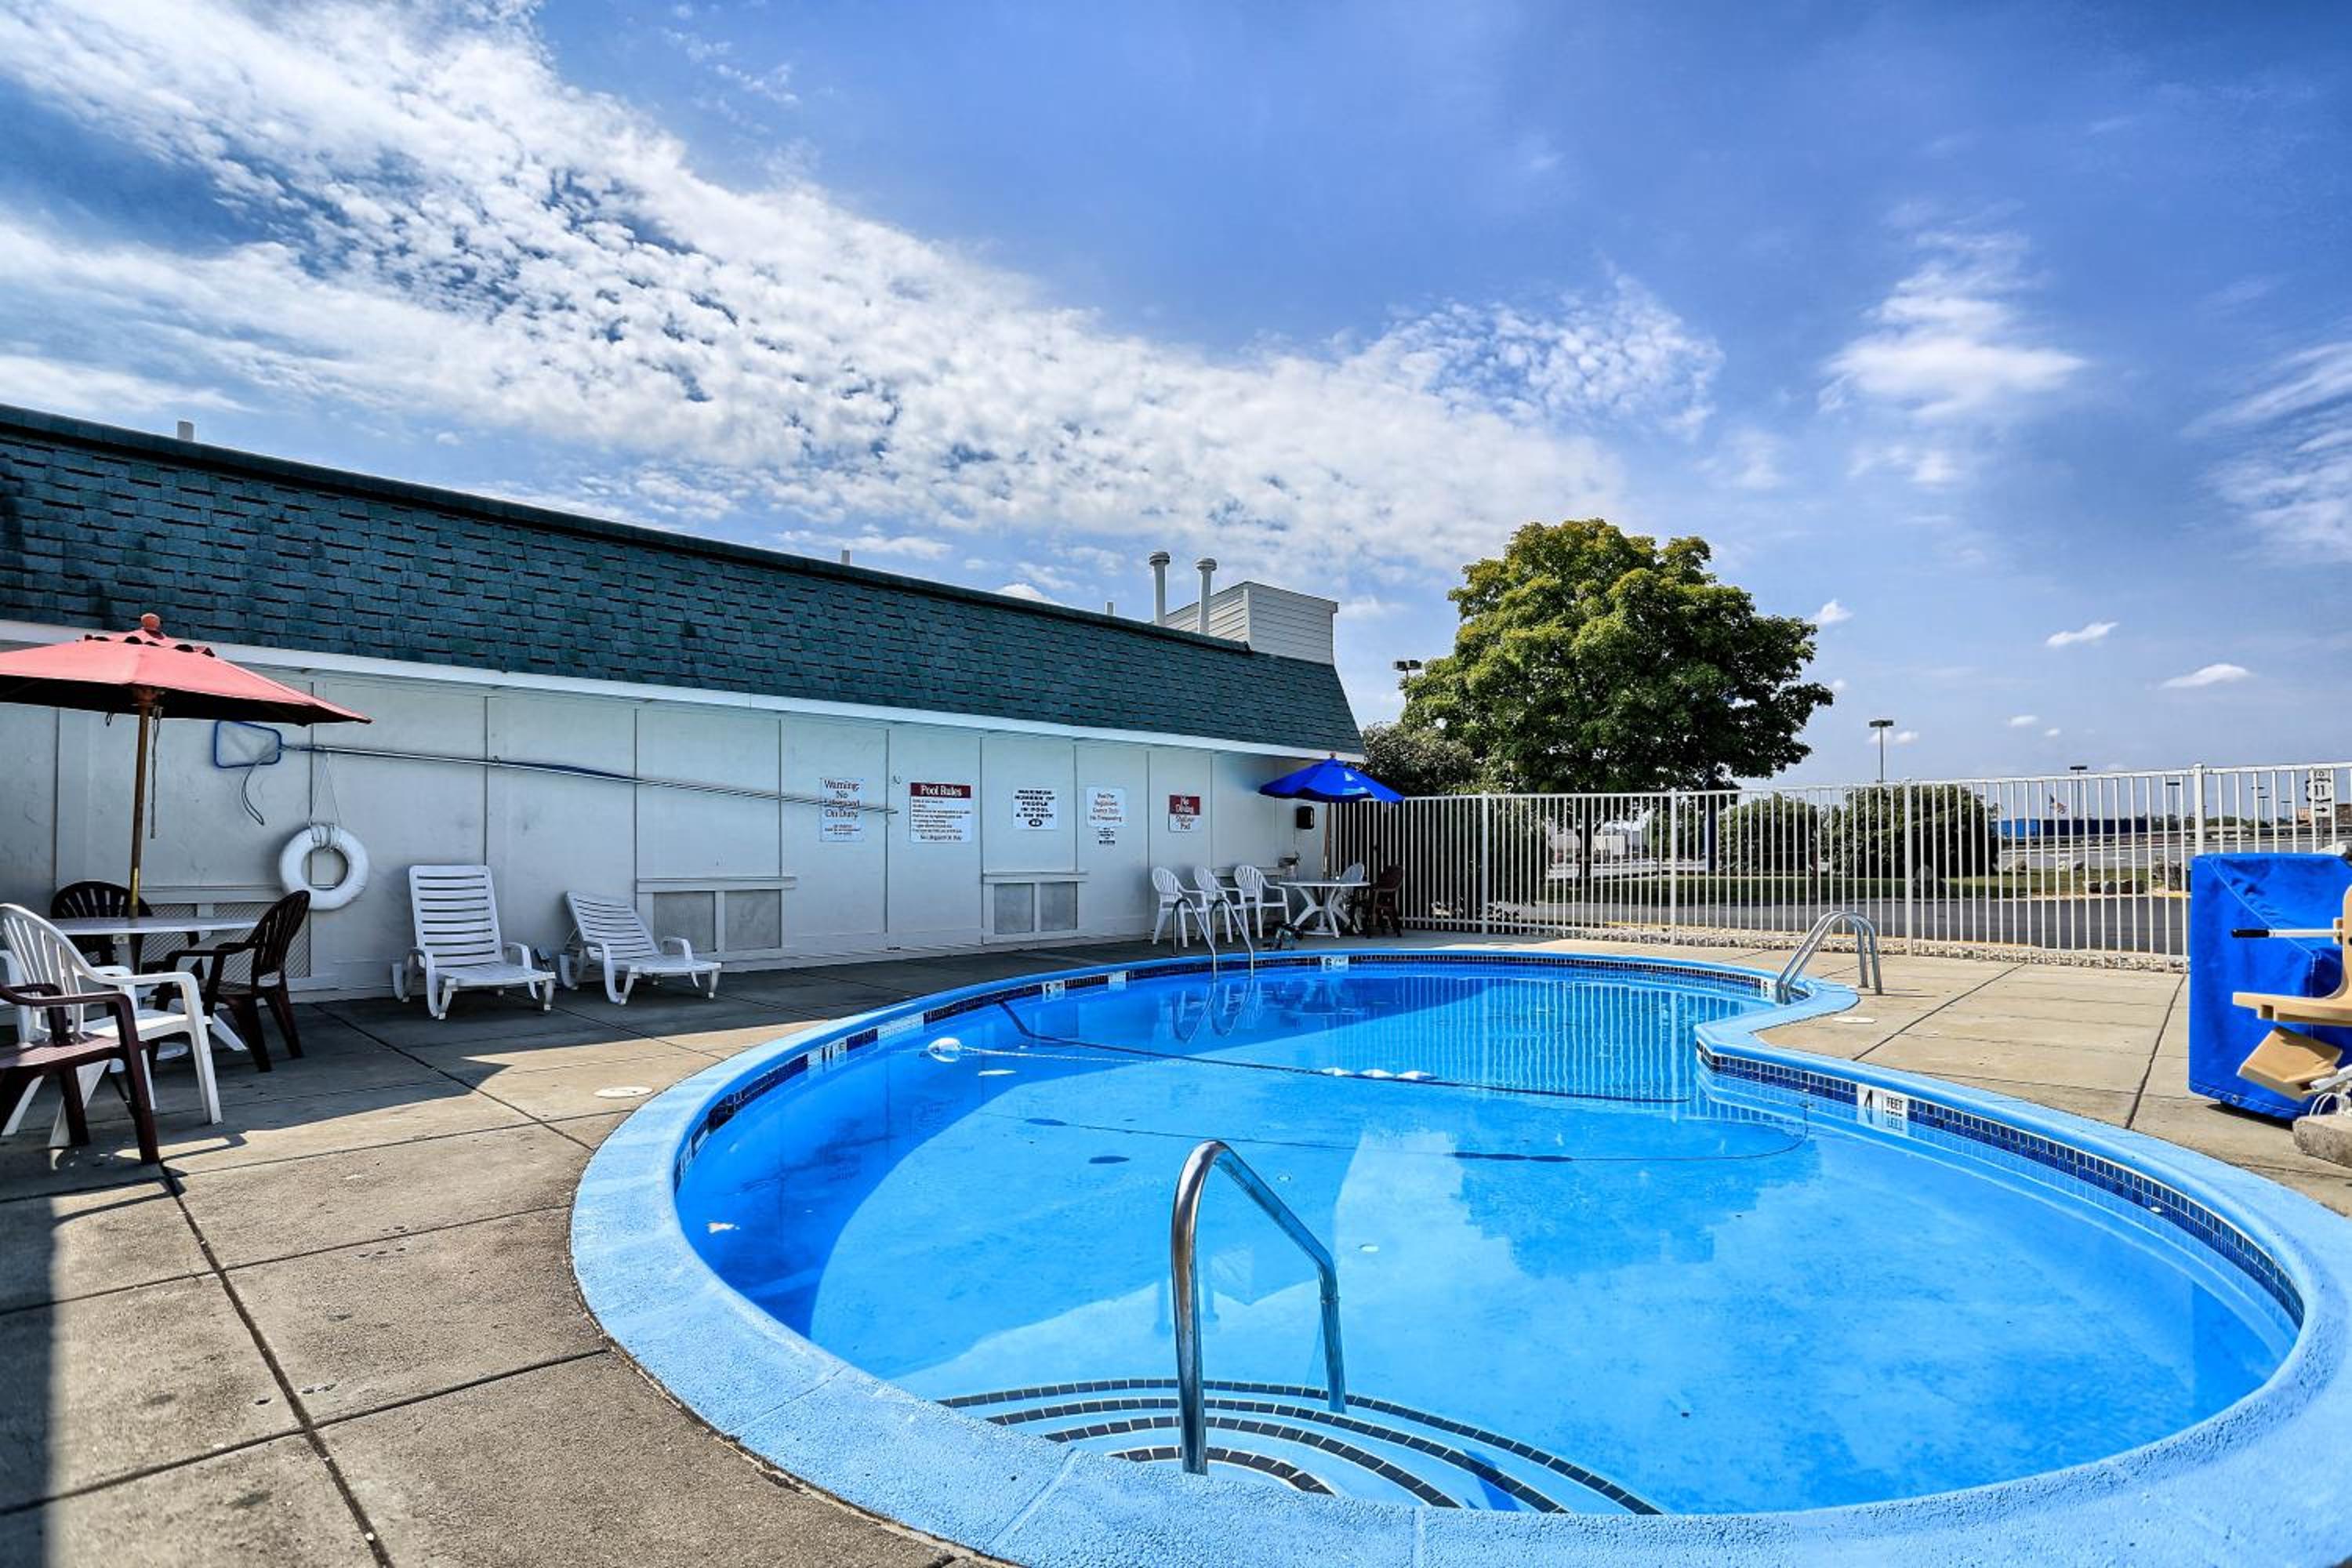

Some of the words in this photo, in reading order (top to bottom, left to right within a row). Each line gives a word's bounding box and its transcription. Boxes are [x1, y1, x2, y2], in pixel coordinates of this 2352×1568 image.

[836, 789, 849, 799] No
[920, 785, 939, 796] Pool
[940, 786, 963, 797] Rules
[2314, 785, 2325, 796] 11
